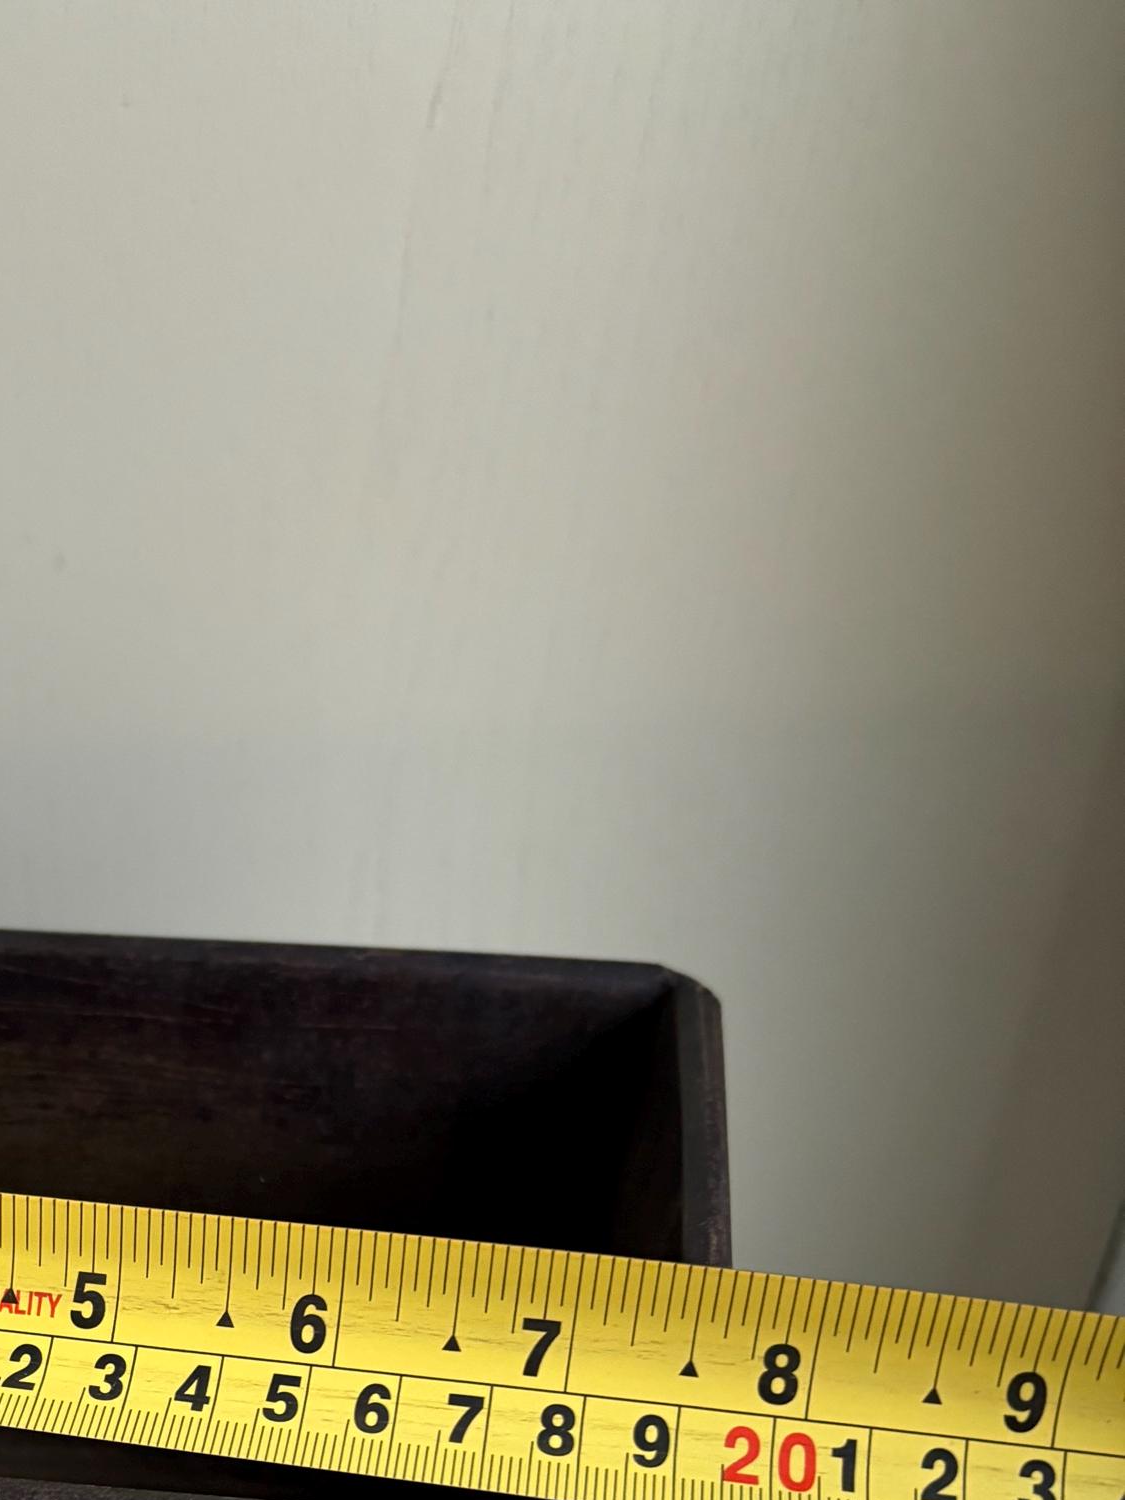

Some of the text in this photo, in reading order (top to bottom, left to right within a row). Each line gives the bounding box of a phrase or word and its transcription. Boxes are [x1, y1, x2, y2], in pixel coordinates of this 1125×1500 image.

[1, 1344, 42, 1390] 2
[88, 1354, 126, 1399] 3
[175, 1366, 210, 1411] 4
[263, 1375, 301, 1421] 5
[354, 1384, 390, 1433] 6
[447, 1394, 484, 1443] 7
[537, 1404, 575, 1456] 8
[633, 1414, 670, 1467] 9
[723, 1427, 816, 1492] 20
[833, 1439, 858, 1492] 1
[71, 1272, 107, 1328] 5
[290, 1295, 328, 1353] 6
[521, 1318, 561, 1376] 7
[758, 1344, 798, 1404] 8
[1004, 1371, 1047, 1432] 9
